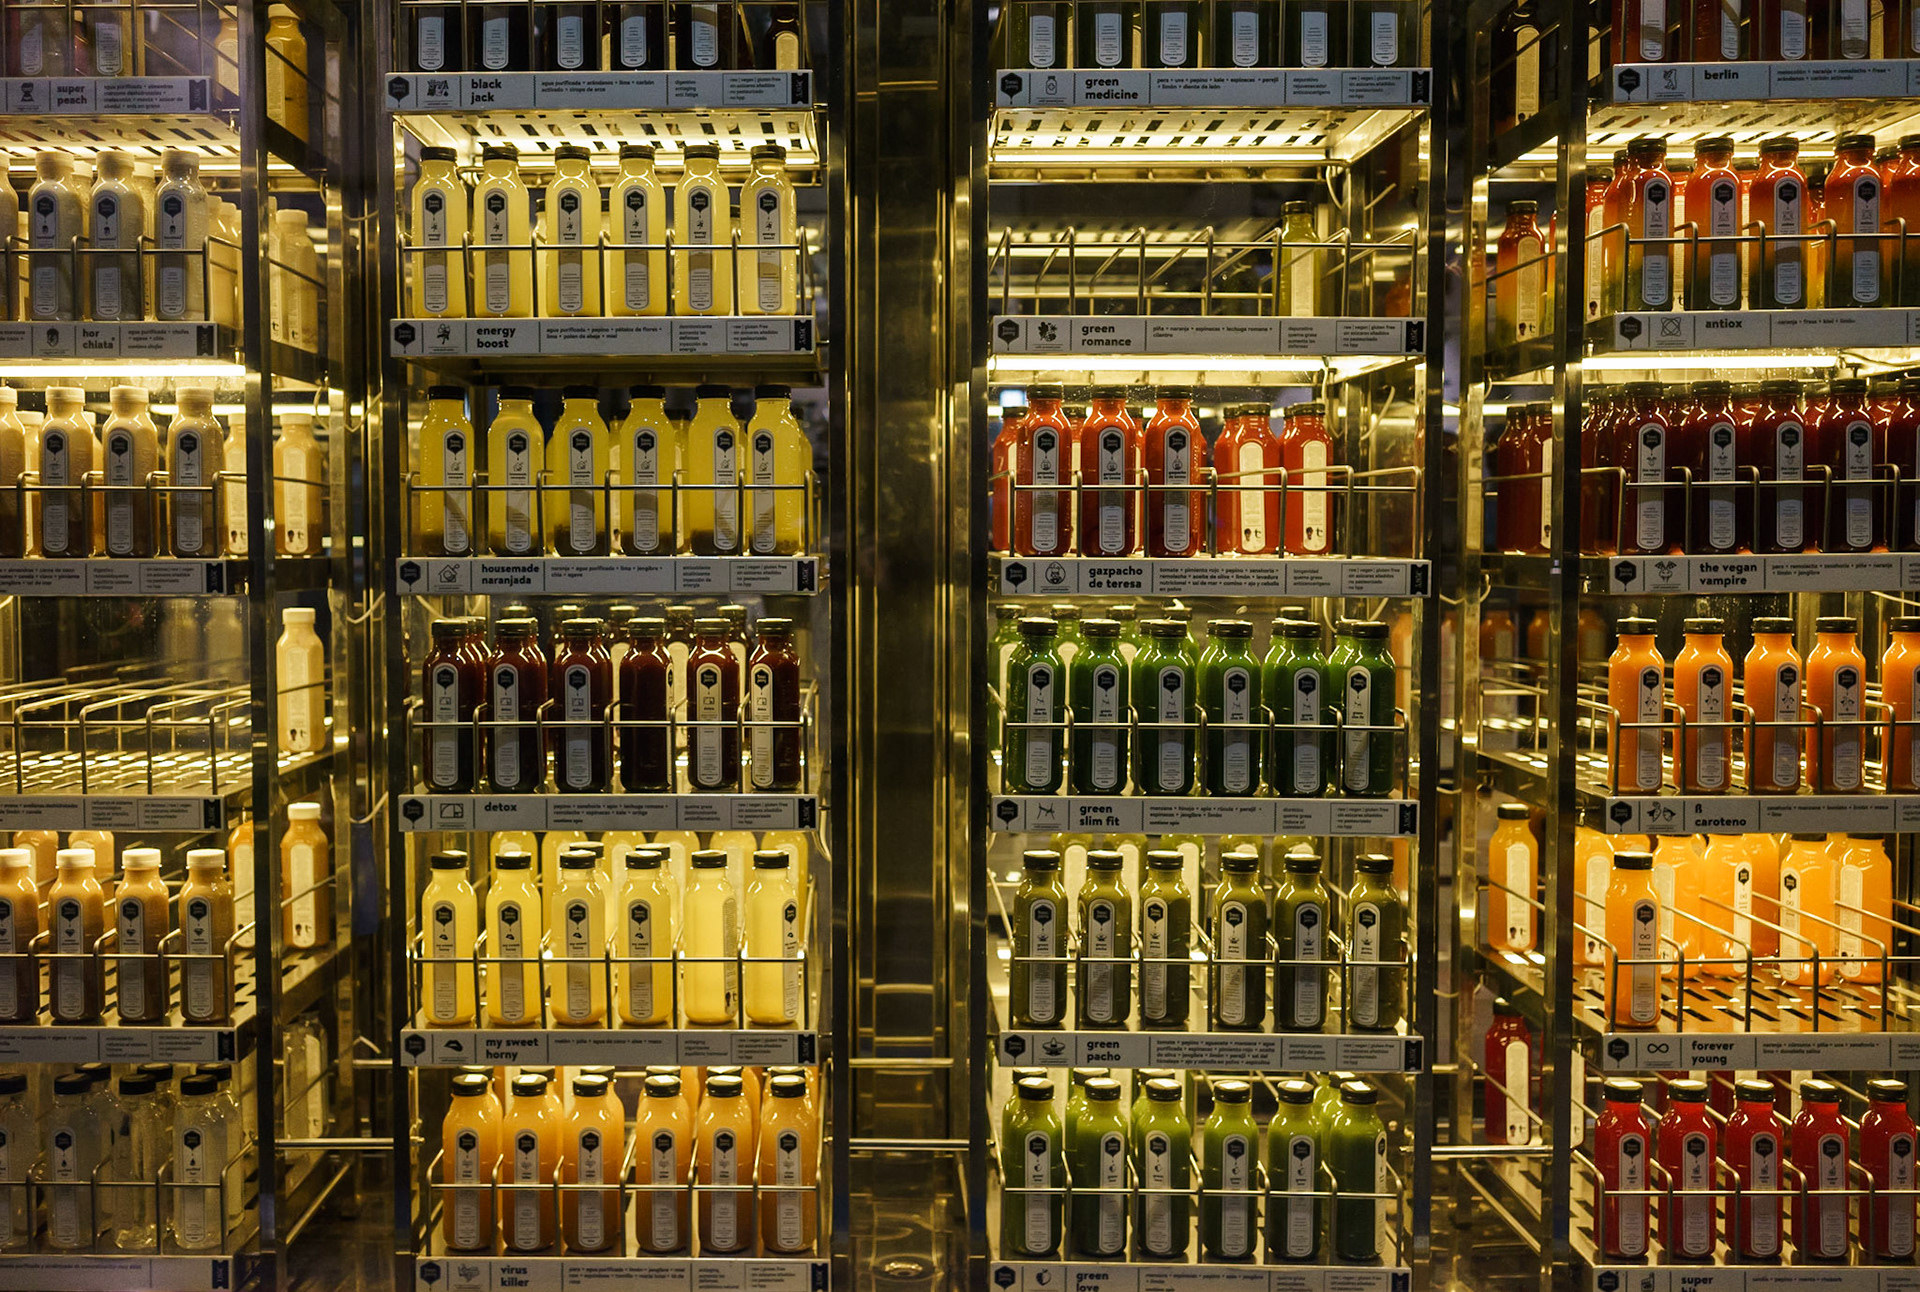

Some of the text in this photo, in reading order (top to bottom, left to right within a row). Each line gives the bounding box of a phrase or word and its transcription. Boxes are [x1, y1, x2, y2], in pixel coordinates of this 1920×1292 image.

[1704, 70, 1739, 80] berlin
[472, 79, 502, 89] black
[1085, 79, 1119, 88] green
[57, 86, 85, 95] super
[1085, 90, 1138, 99] medicine
[57, 95, 87, 106] peach
[471, 92, 494, 105] jack
[1706, 319, 1742, 328] antiox
[83, 329, 100, 337] hor
[477, 328, 516, 338] energy
[1082, 326, 1115, 336] green
[83, 339, 113, 349] chiata
[477, 339, 509, 348] boost
[482, 564, 540, 572] housemade
[1089, 566, 1143, 578] gazpacho
[1700, 563, 1757, 574] the vegan
[482, 576, 531, 586] naranjada
[1089, 578, 1142, 588] de teresa
[1700, 576, 1747, 587] vampire
[484, 802, 517, 812] detox
[1080, 806, 1112, 816] green
[1080, 816, 1119, 826] slim fit
[1695, 818, 1746, 826] caroteno
[486, 1040, 503, 1049] my
[1087, 1042, 1120, 1051] green
[1692, 1041, 1735, 1050] forever
[486, 1050, 518, 1061] horny
[1087, 1052, 1121, 1063] pacho
[1692, 1056, 1727, 1066] young
[501, 1265, 528, 1274] virus
[501, 1278, 529, 1286] killer
[1076, 1273, 1109, 1282] green
[1681, 1278, 1713, 1287] super
[1076, 1282, 1099, 1292] love
